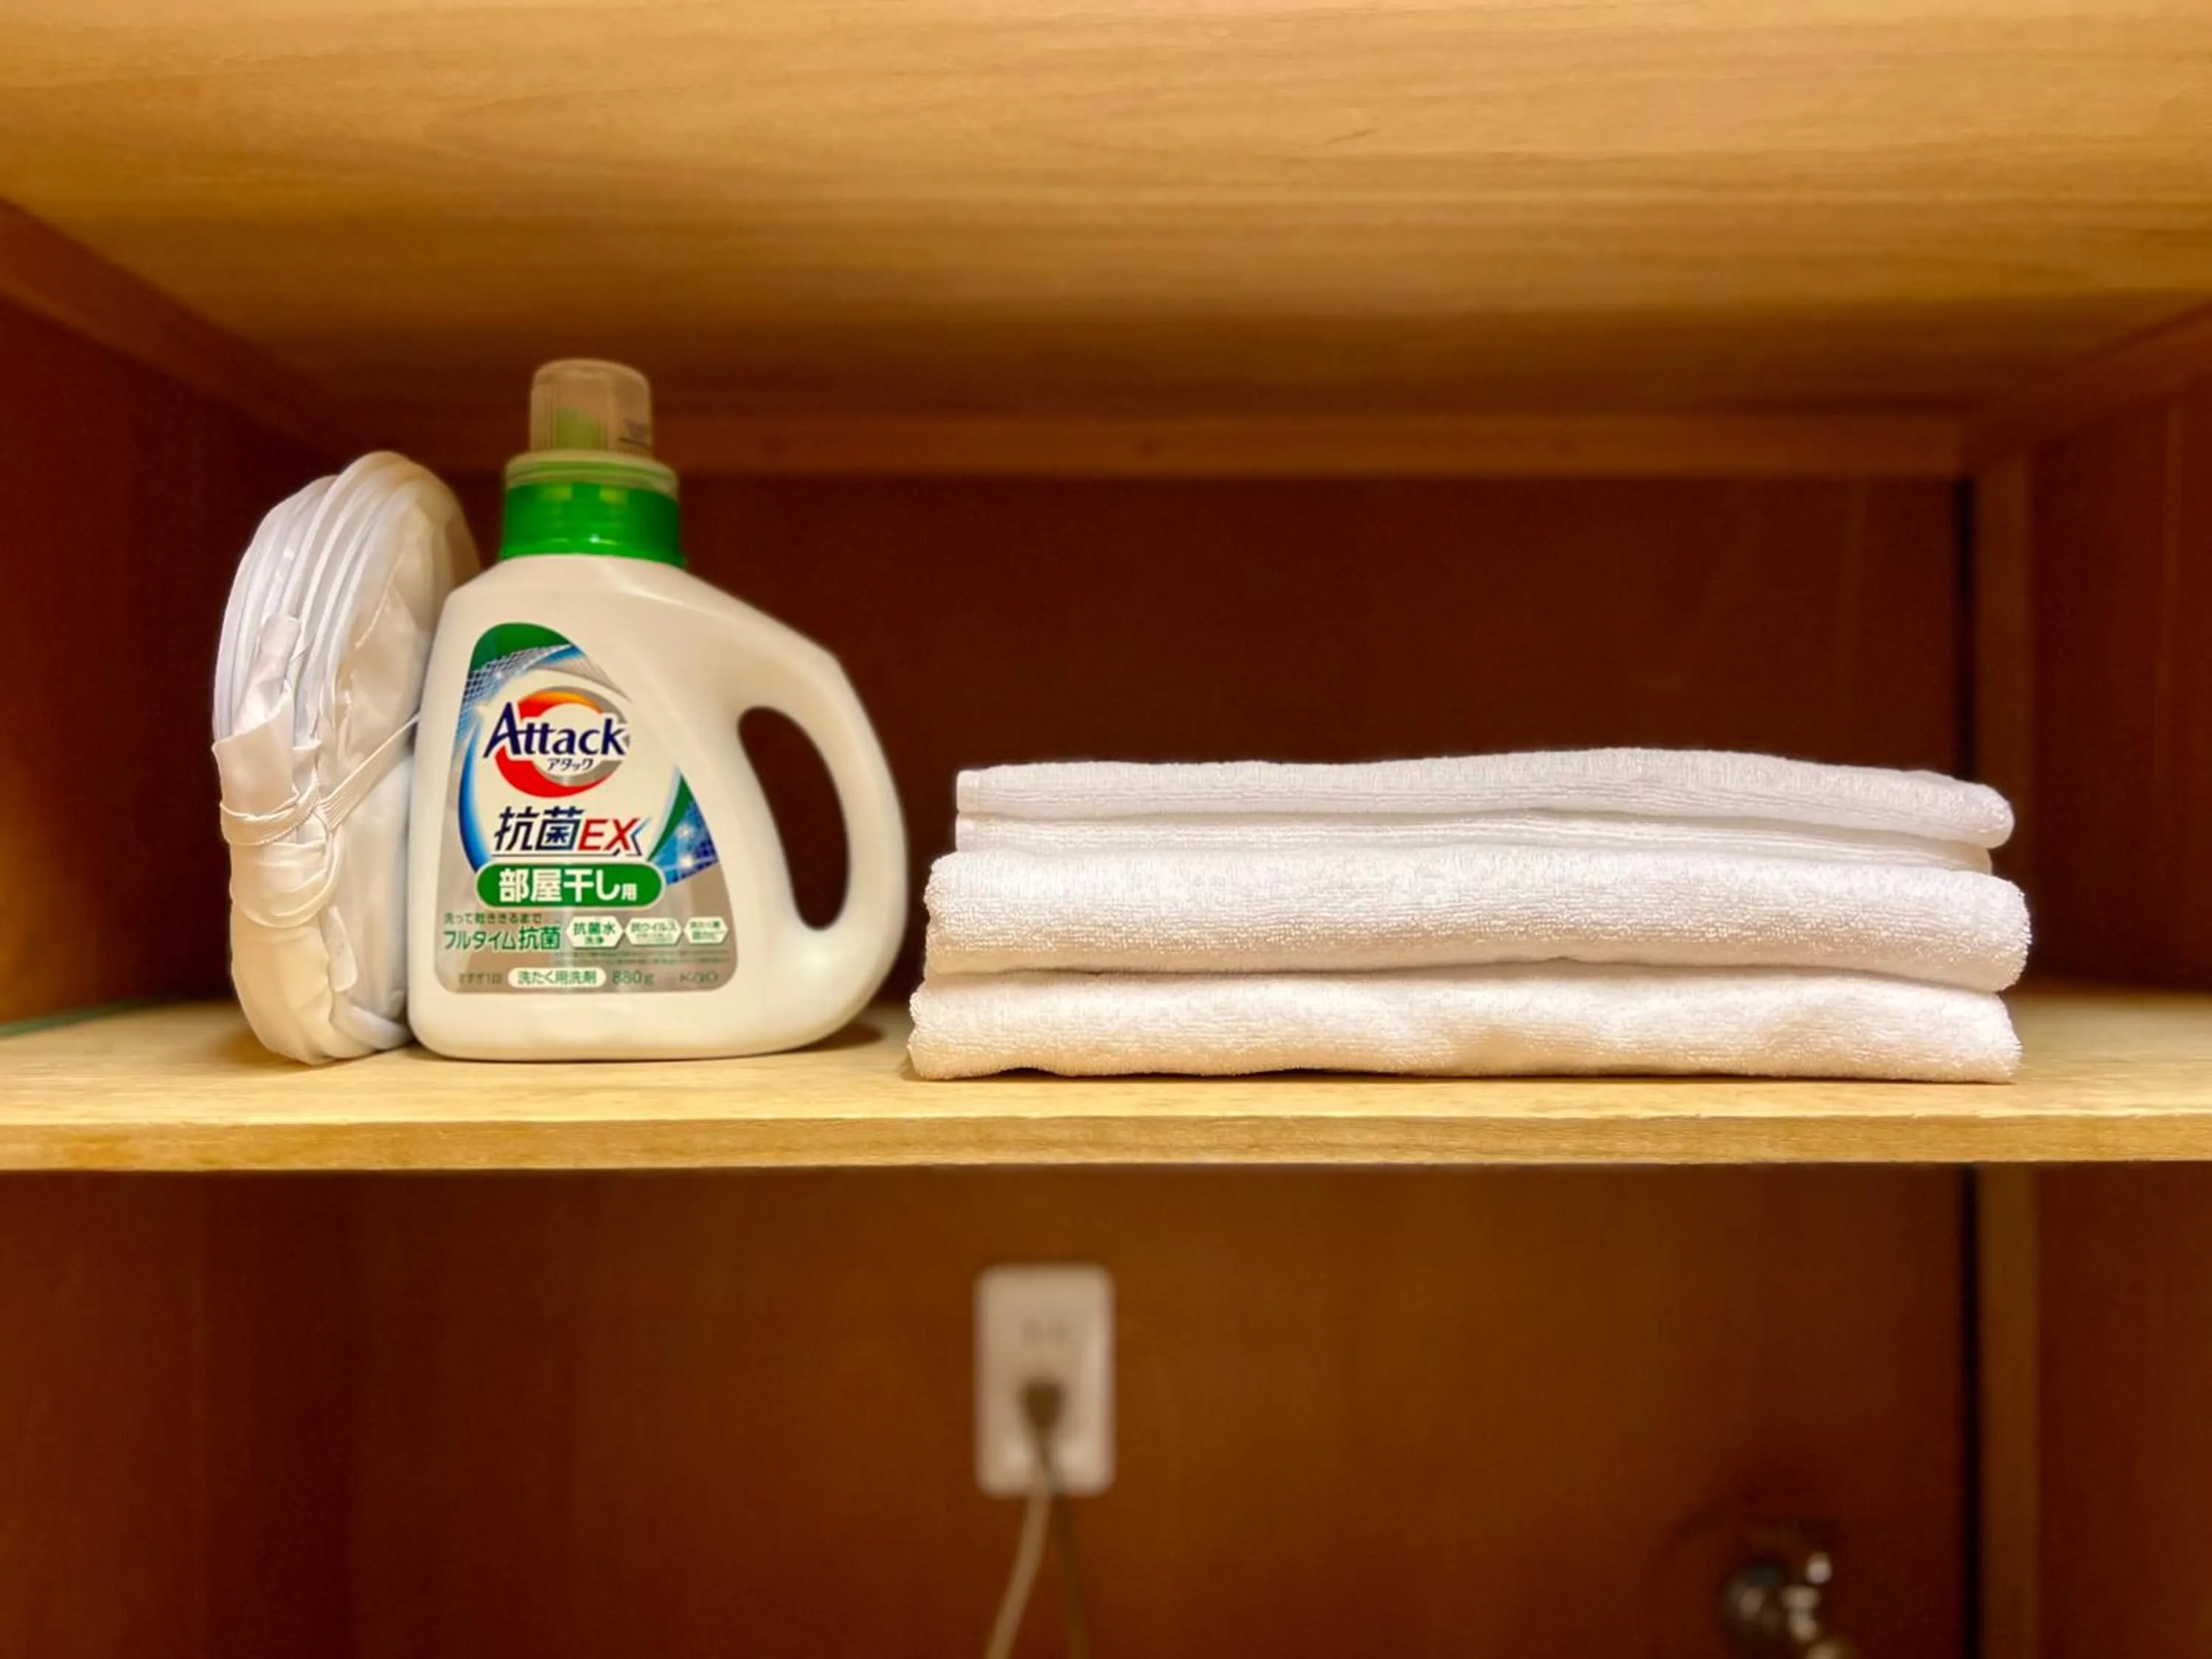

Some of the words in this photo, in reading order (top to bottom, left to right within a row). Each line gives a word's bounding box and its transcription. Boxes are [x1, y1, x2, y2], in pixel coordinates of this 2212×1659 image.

[483, 701, 627, 759] Attack
[546, 758, 594, 771] アタック
[494, 806, 641, 851] 抗菌EX
[498, 868, 638, 903] 部屋干し用
